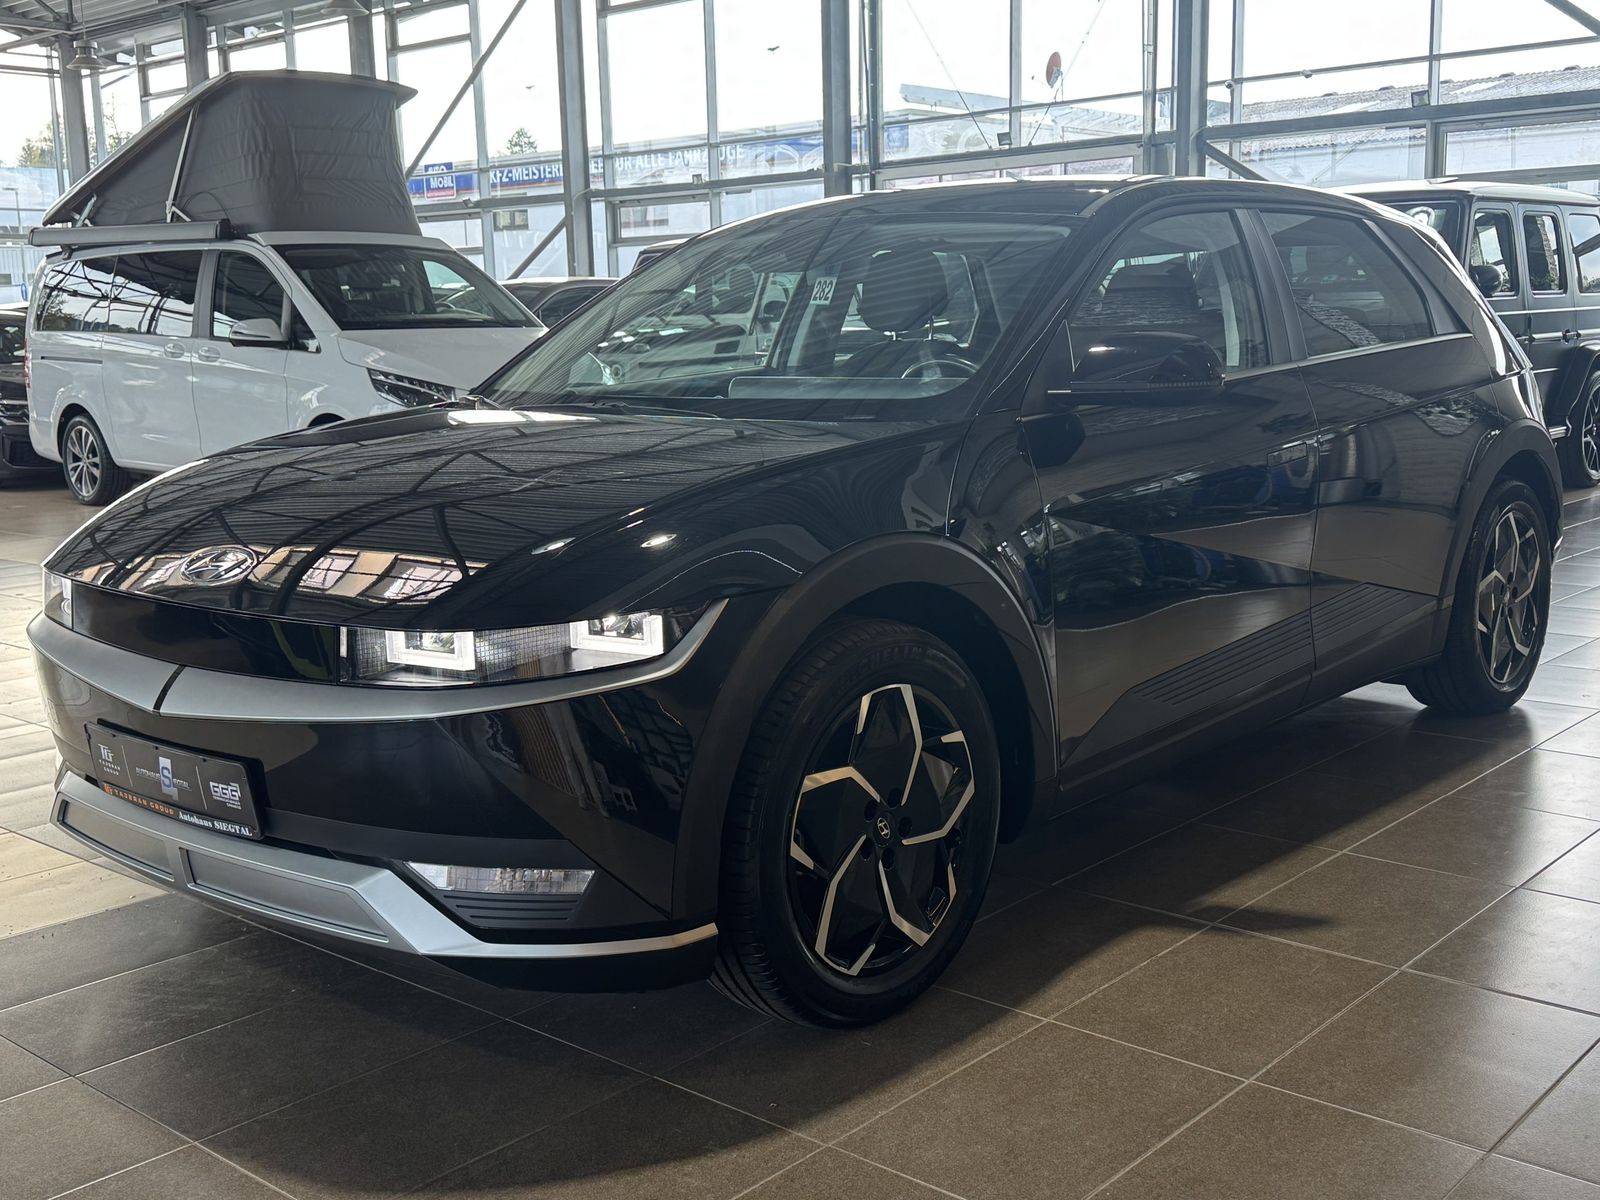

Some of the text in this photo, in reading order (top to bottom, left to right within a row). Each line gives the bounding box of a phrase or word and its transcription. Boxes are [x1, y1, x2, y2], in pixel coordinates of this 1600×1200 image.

[635, 153, 664, 170] ALLE
[668, 144, 745, 167] FAHRZUGE
[430, 174, 454, 189] MOBIL
[812, 279, 833, 302] 282
[179, 811, 252, 837] Autohaus SIEGTAL
